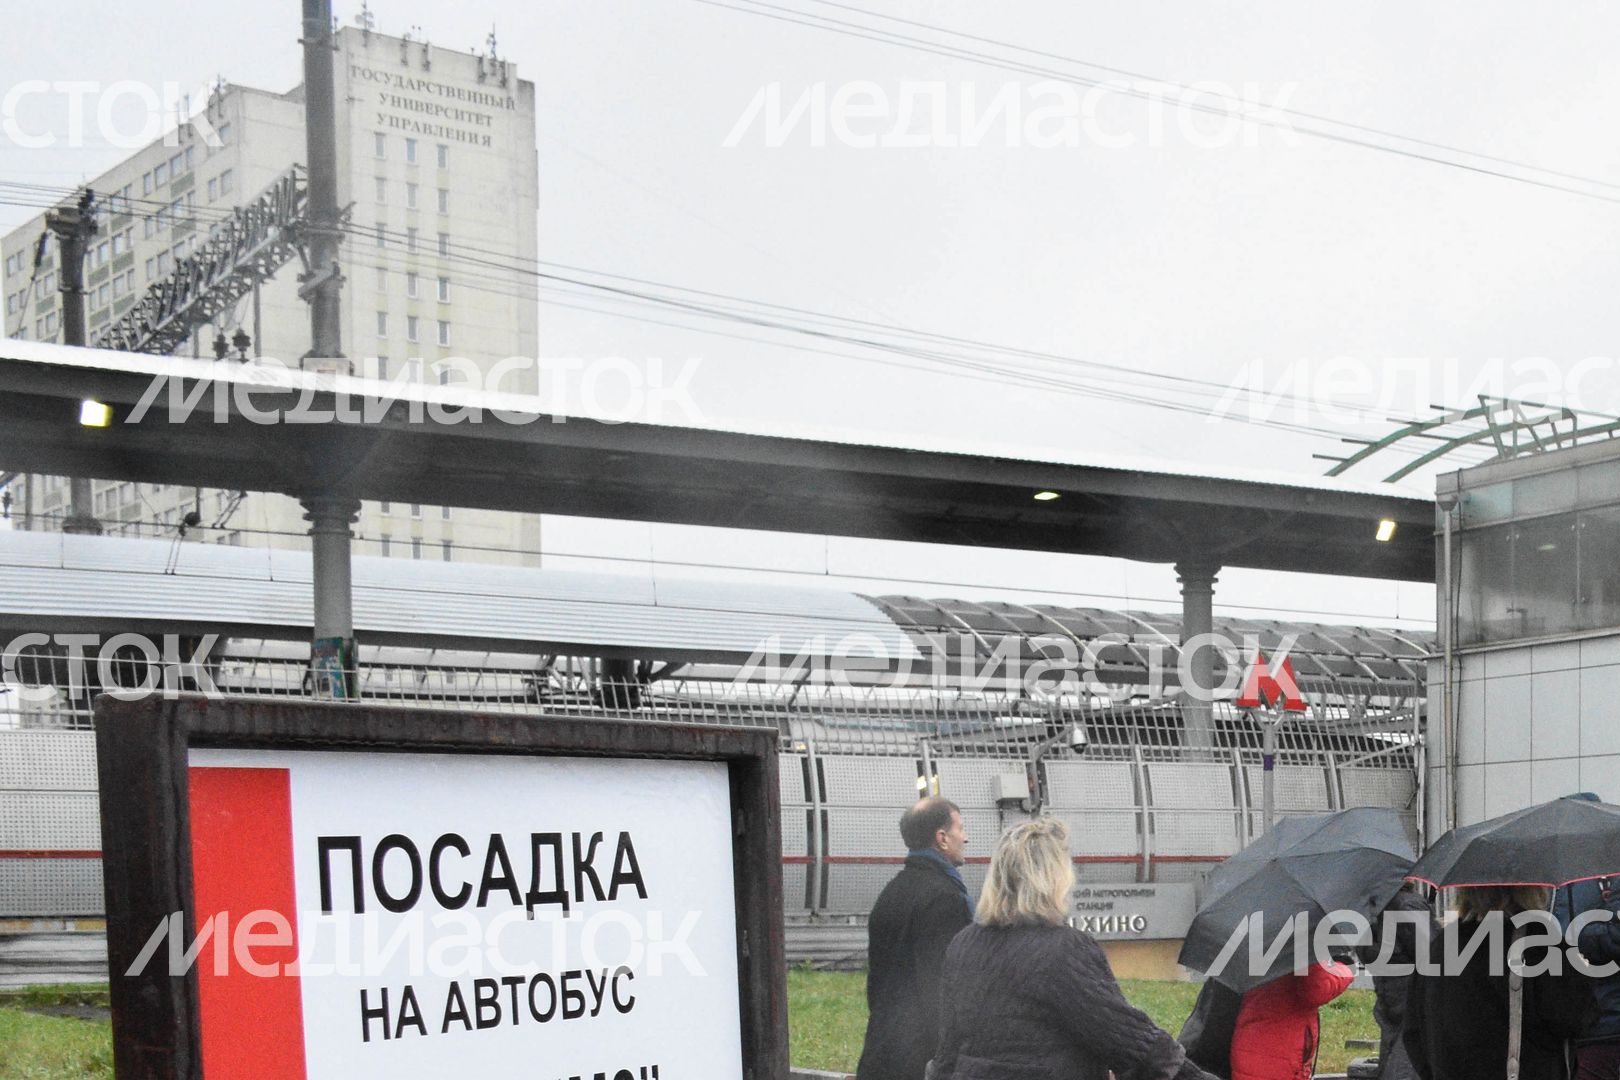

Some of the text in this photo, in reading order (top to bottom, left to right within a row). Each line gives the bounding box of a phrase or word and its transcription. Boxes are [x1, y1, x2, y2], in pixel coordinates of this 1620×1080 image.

[351, 65, 516, 111] ГОСУДАРСТВЕННЫЙ
[379, 92, 493, 127] УНИВЕРСИТЕТ
[376, 112, 492, 147] УПРАВЛЕНИЯ
[318, 830, 648, 920] ПОСАДКА
[360, 964, 636, 1042] НА АВТОБУС
